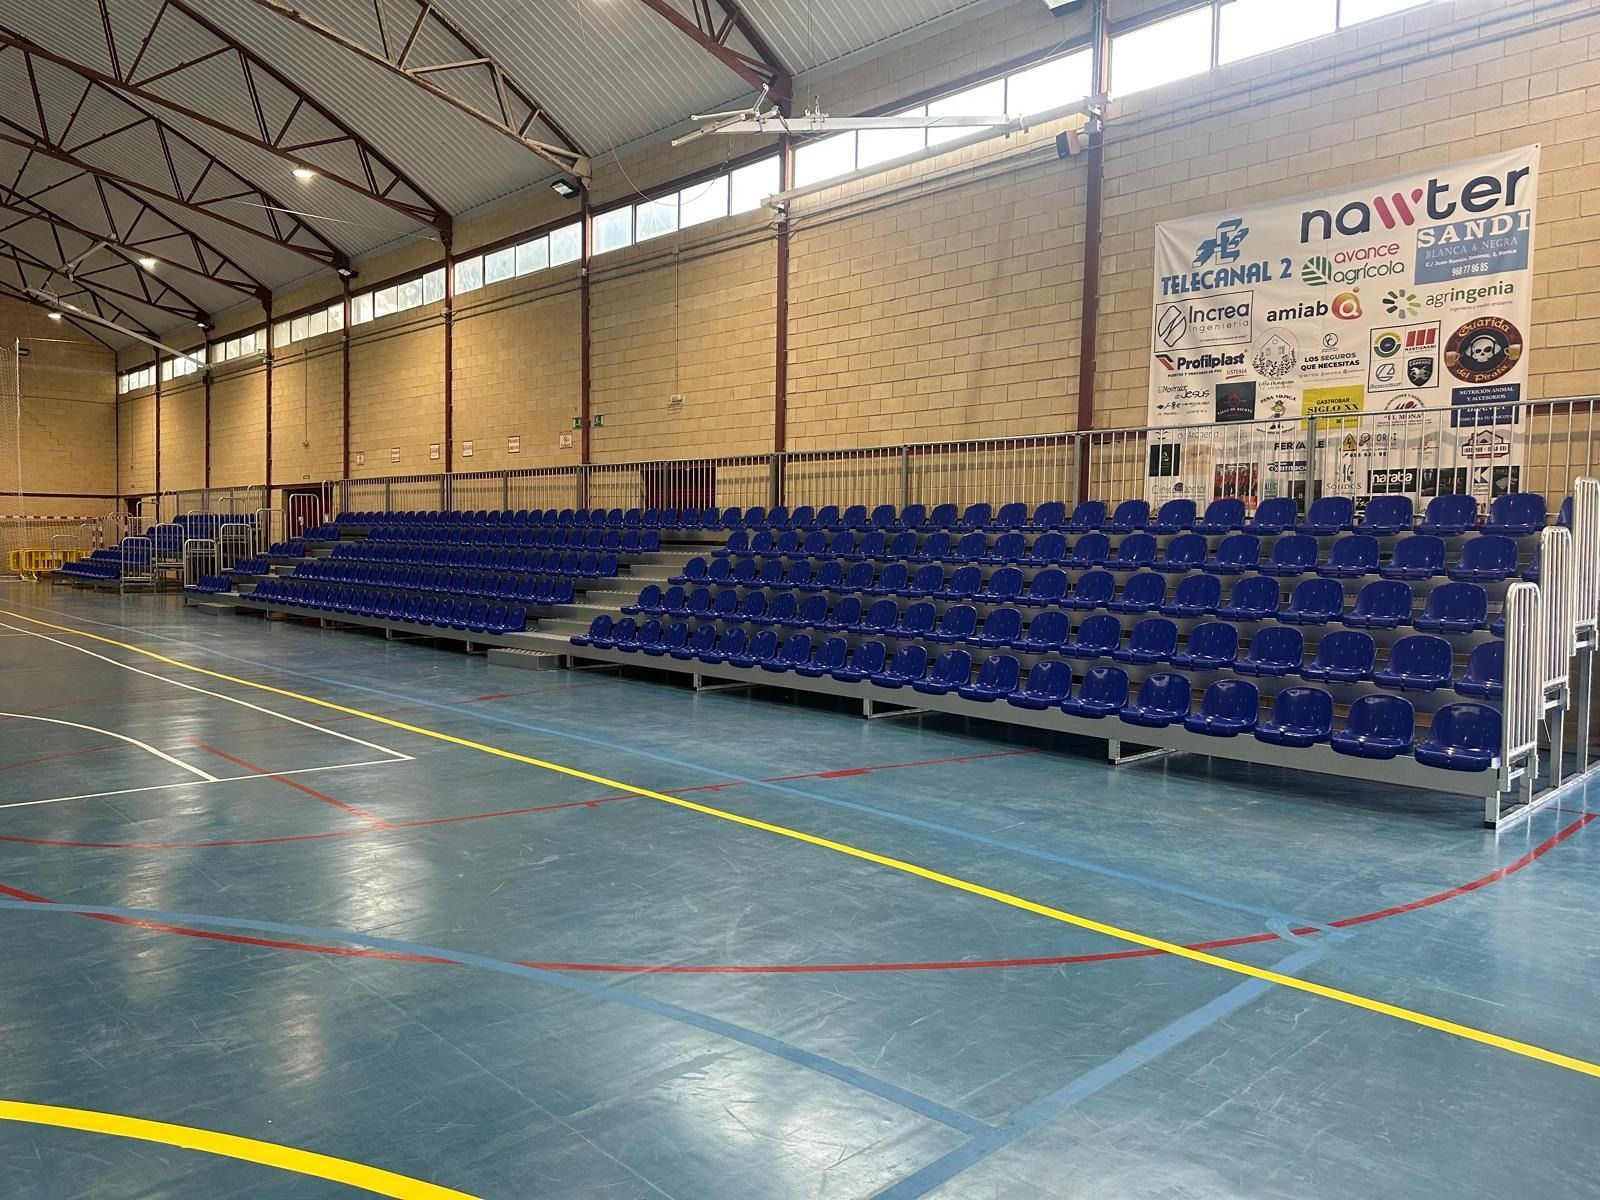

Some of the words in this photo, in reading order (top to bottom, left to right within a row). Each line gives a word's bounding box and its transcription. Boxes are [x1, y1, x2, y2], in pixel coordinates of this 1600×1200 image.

[1417, 210, 1530, 248] SANDI
[1334, 243, 1400, 264] avance
[1426, 245, 1467, 259] BLANCA
[1471, 243, 1478, 252] &
[1482, 236, 1518, 250] NEGRA
[1161, 260, 1272, 296] TELECANAL
[1279, 257, 1292, 279] 2
[1333, 260, 1405, 285] agrícola
[1452, 267, 1463, 276] 968
[1463, 265, 1471, 273] 77
[1480, 262, 1489, 272] 85
[1425, 280, 1514, 308] agringenia
[1188, 303, 1250, 323] Increa
[1266, 300, 1329, 322] amiab
[1458, 318, 1510, 337] Guarida
[1177, 352, 1245, 370] Profilplast
[1300, 363, 1316, 371] QUE
[1318, 360, 1360, 369] NECESITAS
[1304, 355, 1319, 363] LOS
[1320, 352, 1357, 362] SEGUROS
[1456, 368, 1469, 379] del
[1474, 365, 1508, 382] Pirata
[1181, 387, 1210, 399] Jesús
[1460, 387, 1490, 395] NUTRICIÓN
[1307, 405, 1341, 414] SIGLO
[1344, 403, 1359, 411] XX
[1316, 397, 1351, 405] GASTROBAR
